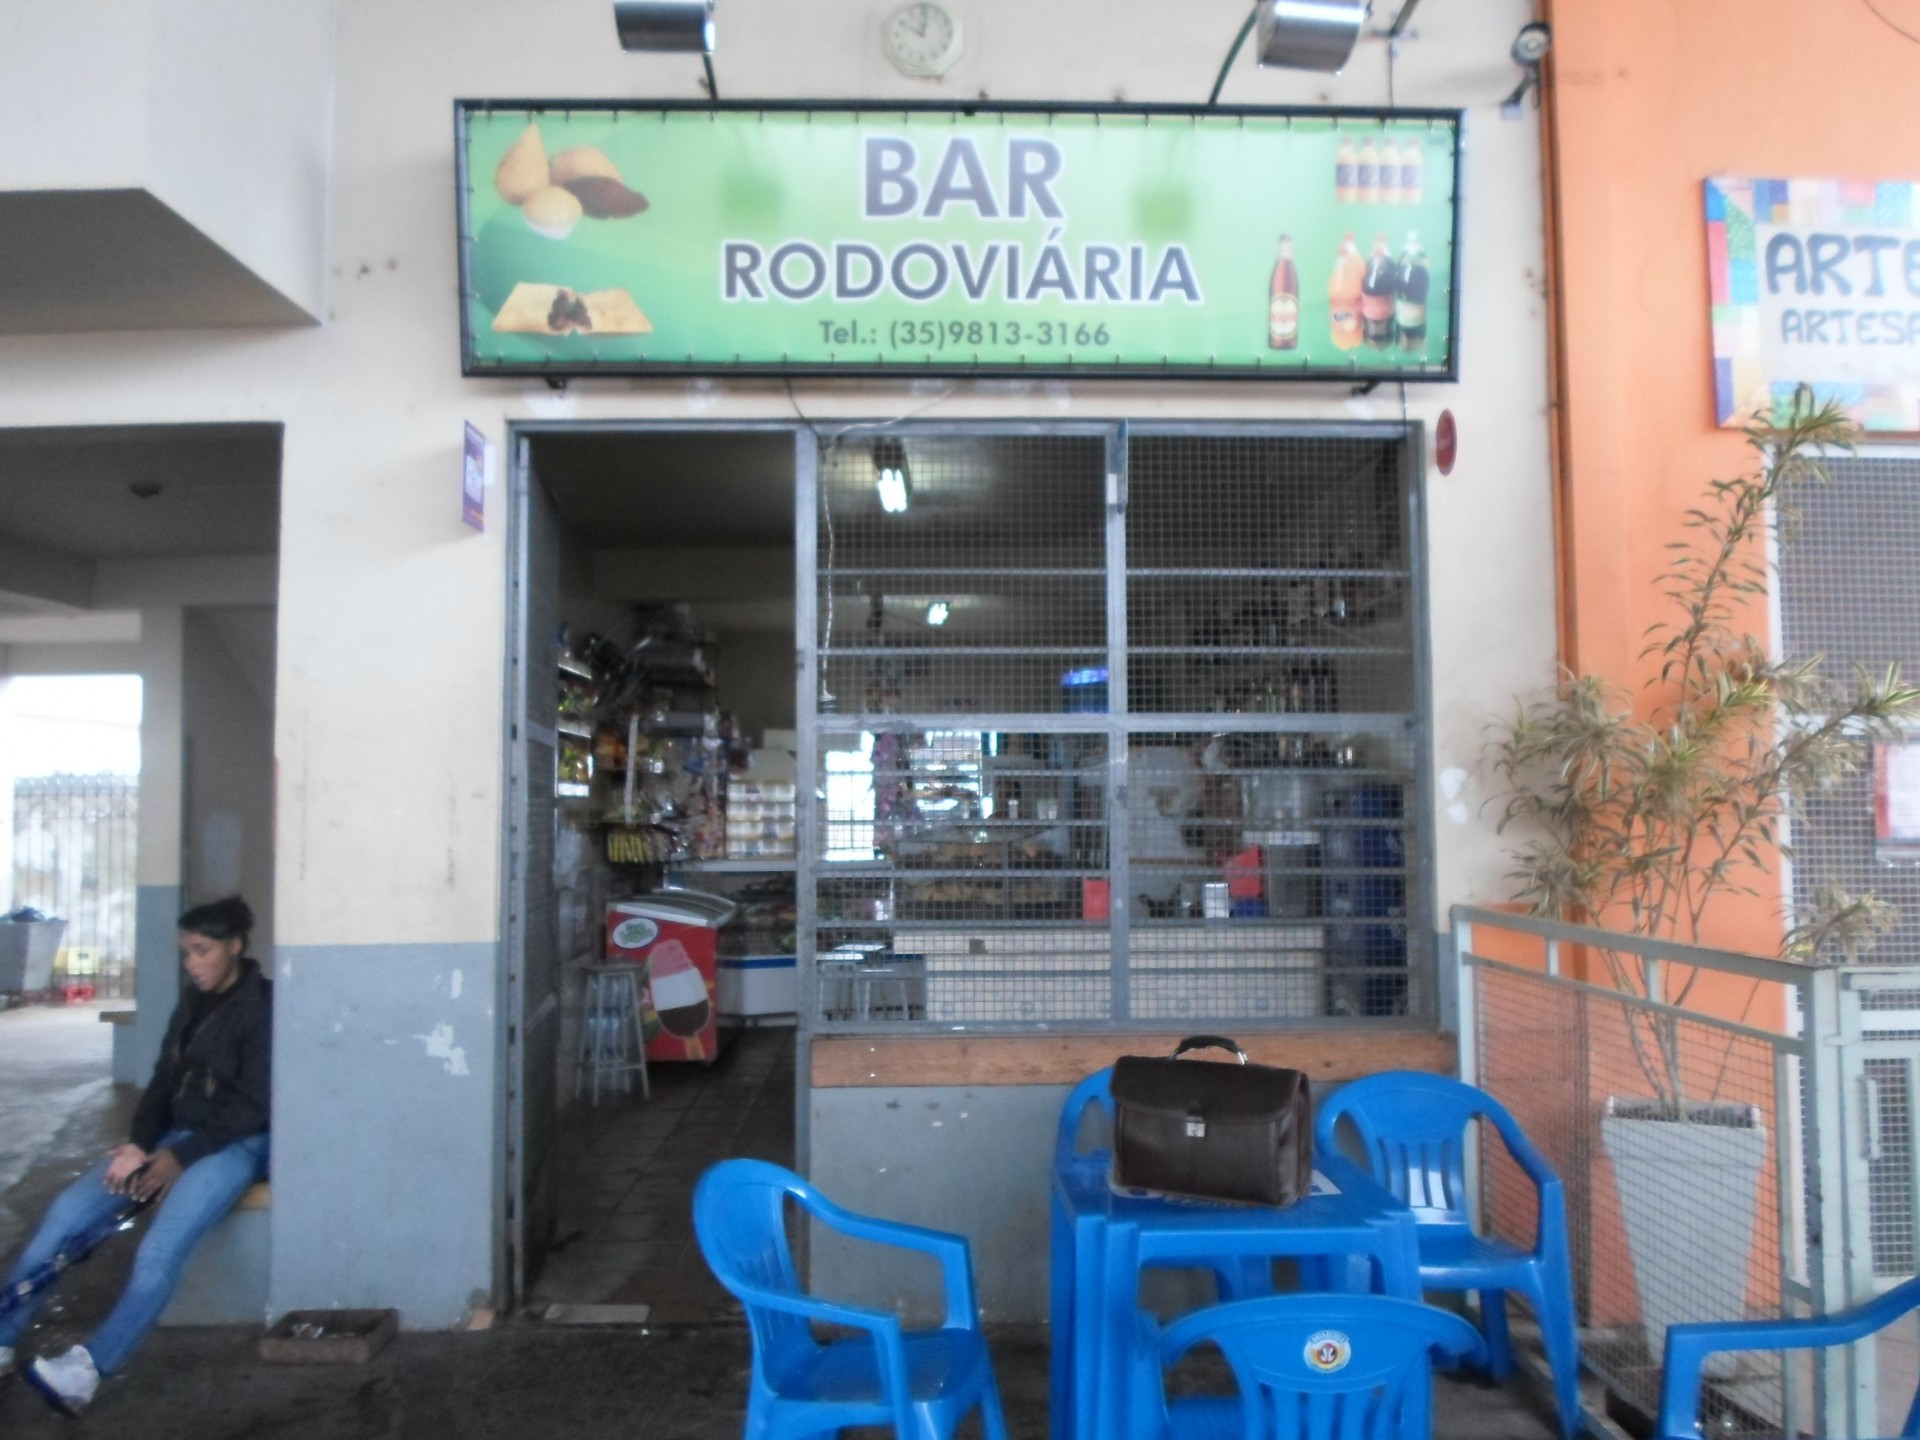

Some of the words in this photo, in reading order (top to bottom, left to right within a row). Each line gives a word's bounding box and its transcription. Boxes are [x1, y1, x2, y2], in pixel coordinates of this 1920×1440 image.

[865, 138, 1064, 218] BAR
[725, 227, 1200, 300] RODOVIÁRIA
[820, 320, 876, 345] Tel.:
[890, 320, 1110, 350] (35)9813-3166
